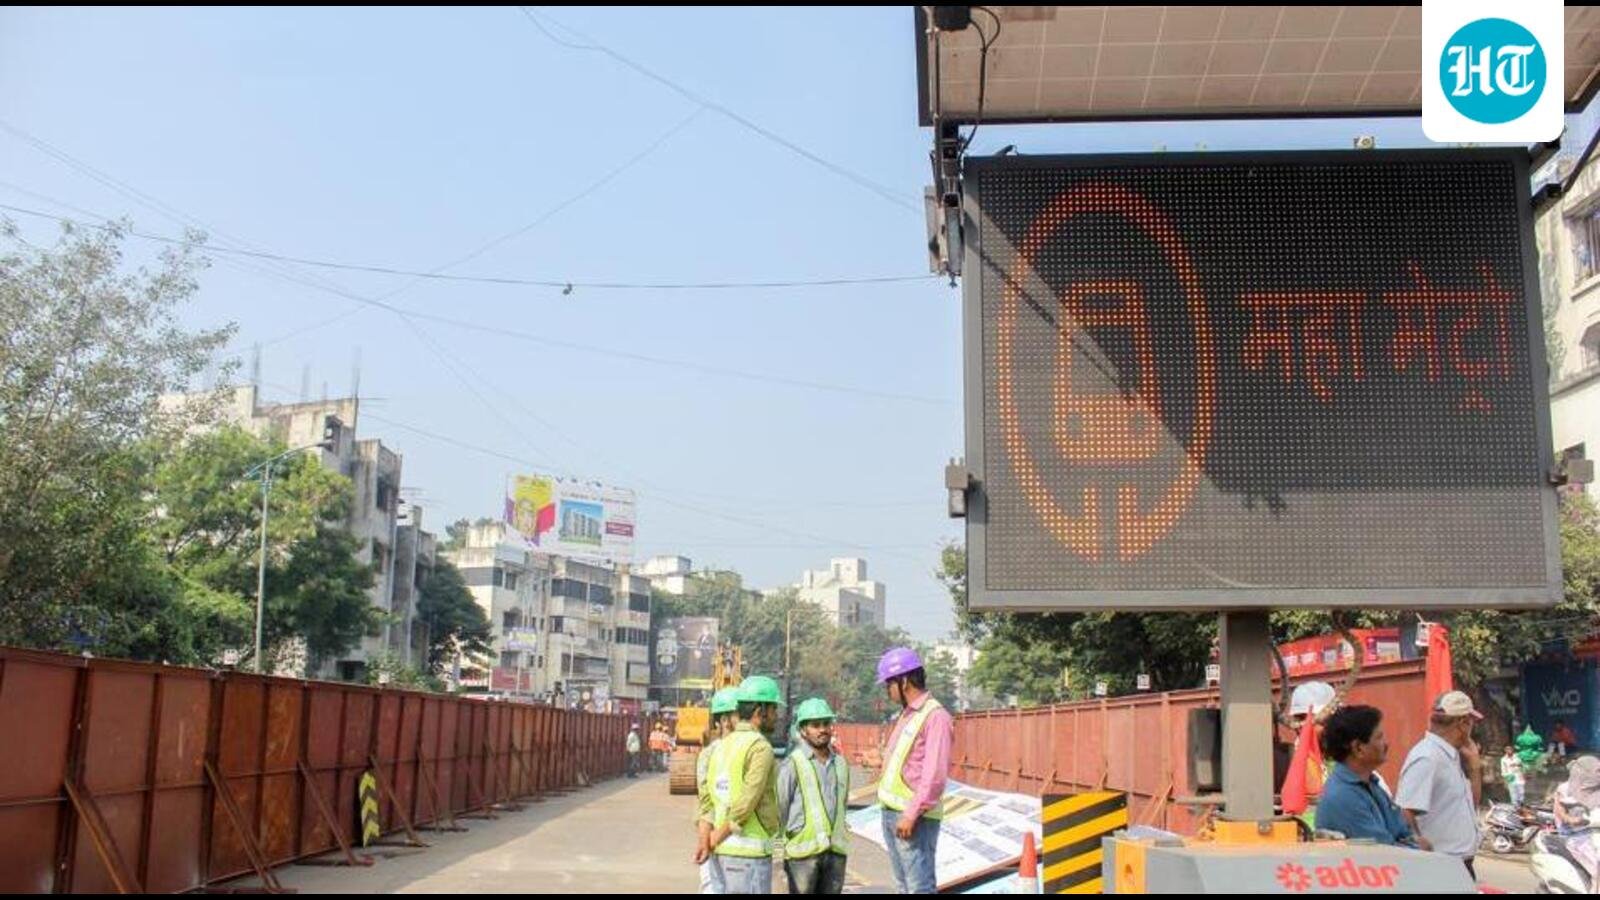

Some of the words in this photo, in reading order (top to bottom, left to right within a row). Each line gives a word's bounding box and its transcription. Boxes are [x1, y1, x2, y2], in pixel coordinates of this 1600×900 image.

[1237, 291, 1368, 404] महा
[1382, 258, 1516, 412] मेट्रो
[1315, 857, 1400, 889] ador
